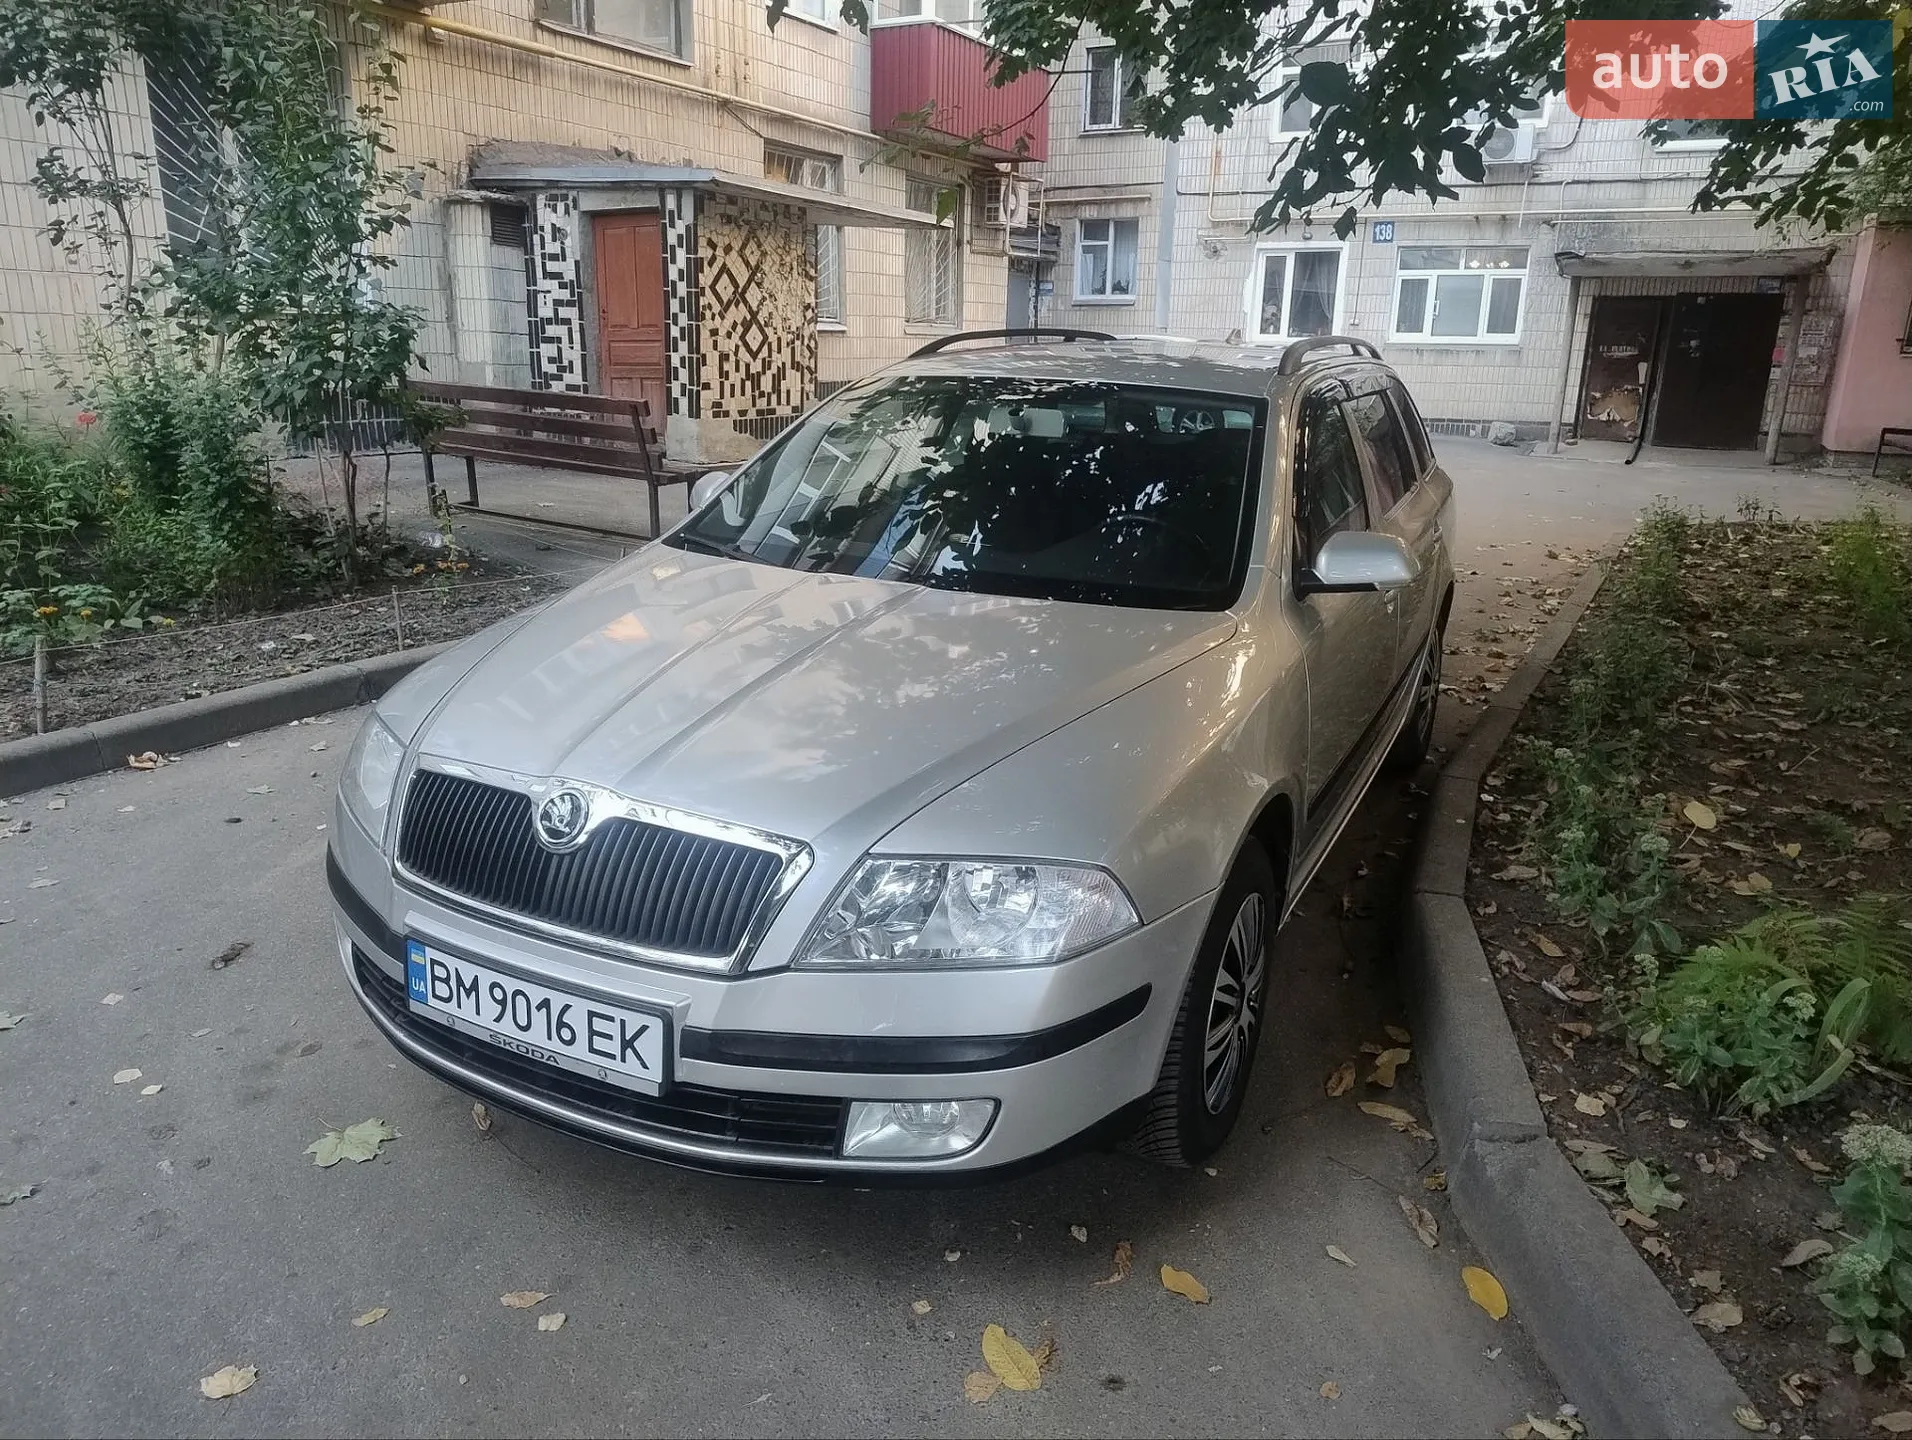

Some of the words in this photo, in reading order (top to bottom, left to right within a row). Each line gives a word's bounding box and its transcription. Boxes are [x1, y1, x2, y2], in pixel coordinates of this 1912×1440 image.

[1375, 224, 1393, 241] 138
[412, 977, 427, 994] UA
[429, 957, 481, 1017] BM
[488, 980, 577, 1046] 9016
[587, 1009, 650, 1070] EK
